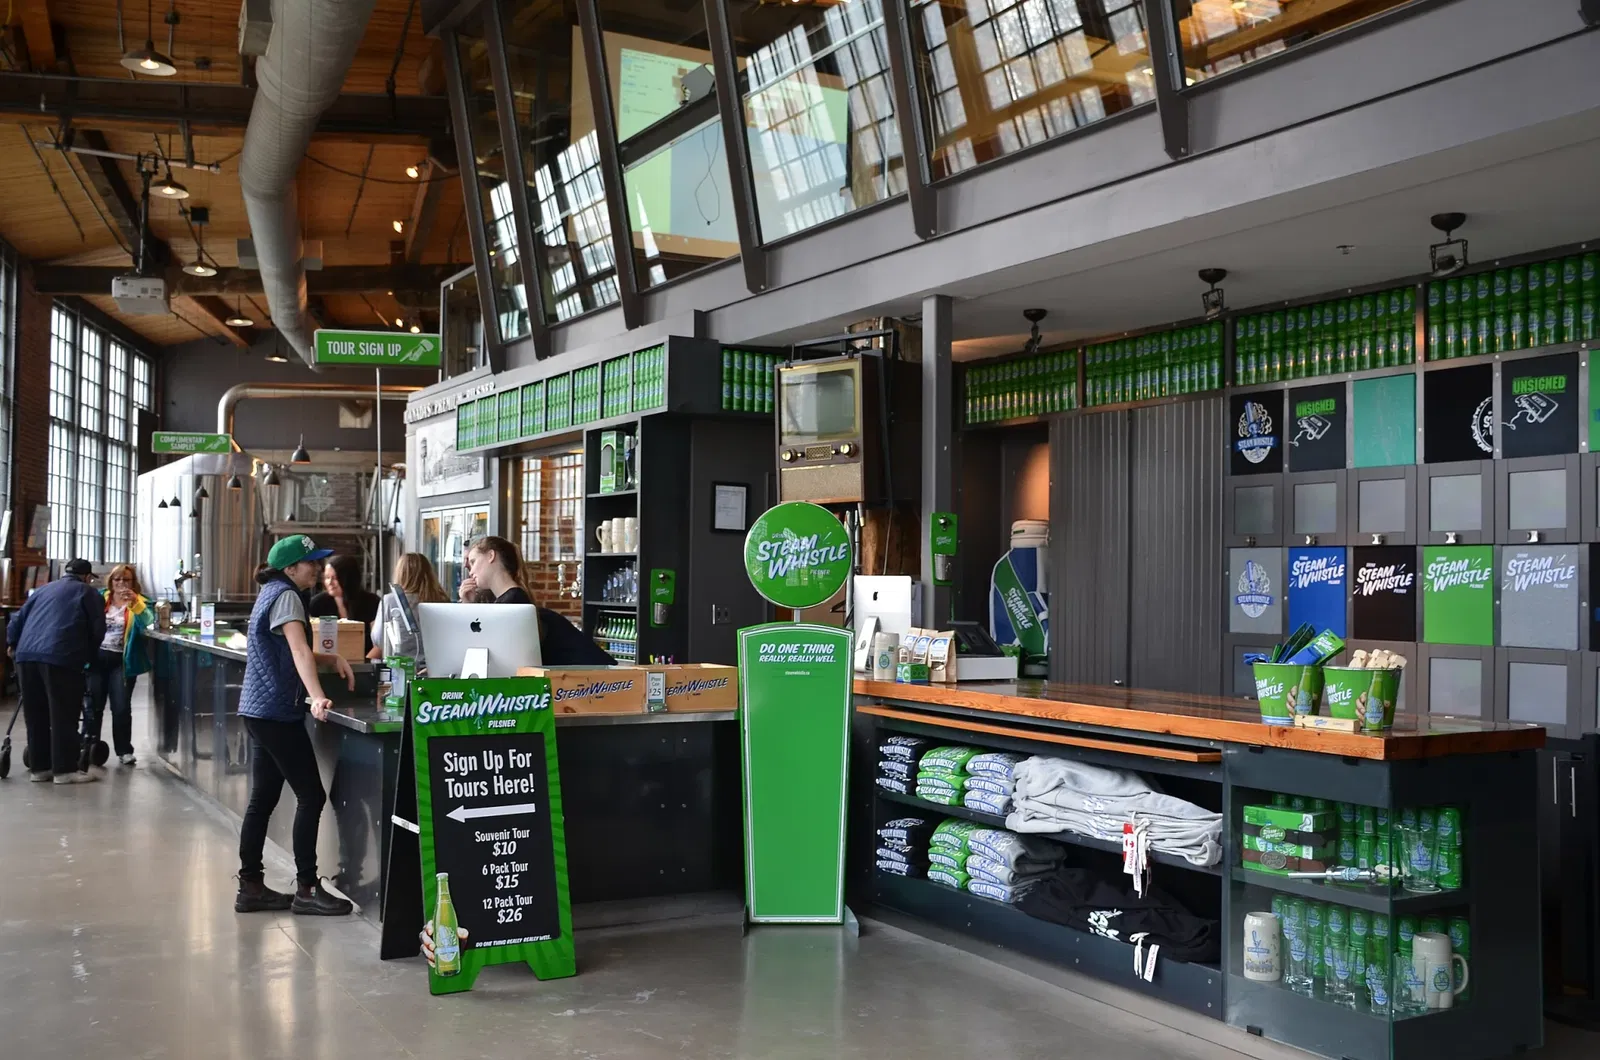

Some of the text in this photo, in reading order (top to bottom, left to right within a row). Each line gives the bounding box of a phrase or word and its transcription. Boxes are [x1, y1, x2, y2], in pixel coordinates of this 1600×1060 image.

[326, 340, 402, 357] TOUR SIGN UP
[1512, 376, 1567, 394] UNSIGNED
[1296, 398, 1336, 417] UNSIGNED
[160, 435, 206, 444] COMPLIMENTARY
[170, 443, 196, 451] SAMPLES
[756, 534, 819, 561] STEAM
[768, 543, 848, 580] WHISTLE
[1291, 557, 1327, 576] STEAM
[1426, 559, 1469, 579] STEAM
[1506, 556, 1553, 576] STEAM
[1298, 564, 1345, 589] WHISTLE
[1356, 564, 1396, 583] STEAM
[1433, 567, 1492, 592] WHISTLE
[1514, 565, 1576, 592] WHISTLE
[1363, 573, 1414, 596] WHISTLE
[1009, 587, 1028, 617] STEAM
[1007, 596, 1033, 630] WHISTLE
[759, 643, 835, 654] DO ONE THING
[759, 654, 836, 664] REALLY, REALLY WELL.
[441, 692, 464, 700] DRINK
[488, 719, 516, 728] PILSNER
[443, 749, 532, 776] Sign Up For
[922, 759, 957, 769] STEAM WHISTLE
[974, 762, 1010, 776] STEAM WHISTLE
[444, 773, 535, 798] Tours Here!
[934, 787, 955, 797] WHISTLE
[970, 779, 1004, 793] STEAM WHISTLE
[475, 827, 530, 842] Souvenir Tour
[492, 840, 517, 857] $10
[482, 861, 529, 875] 6 Pack Tour
[494, 873, 519, 890] $15
[482, 894, 533, 909] 12 Pack Tour
[496, 907, 523, 924] $26
